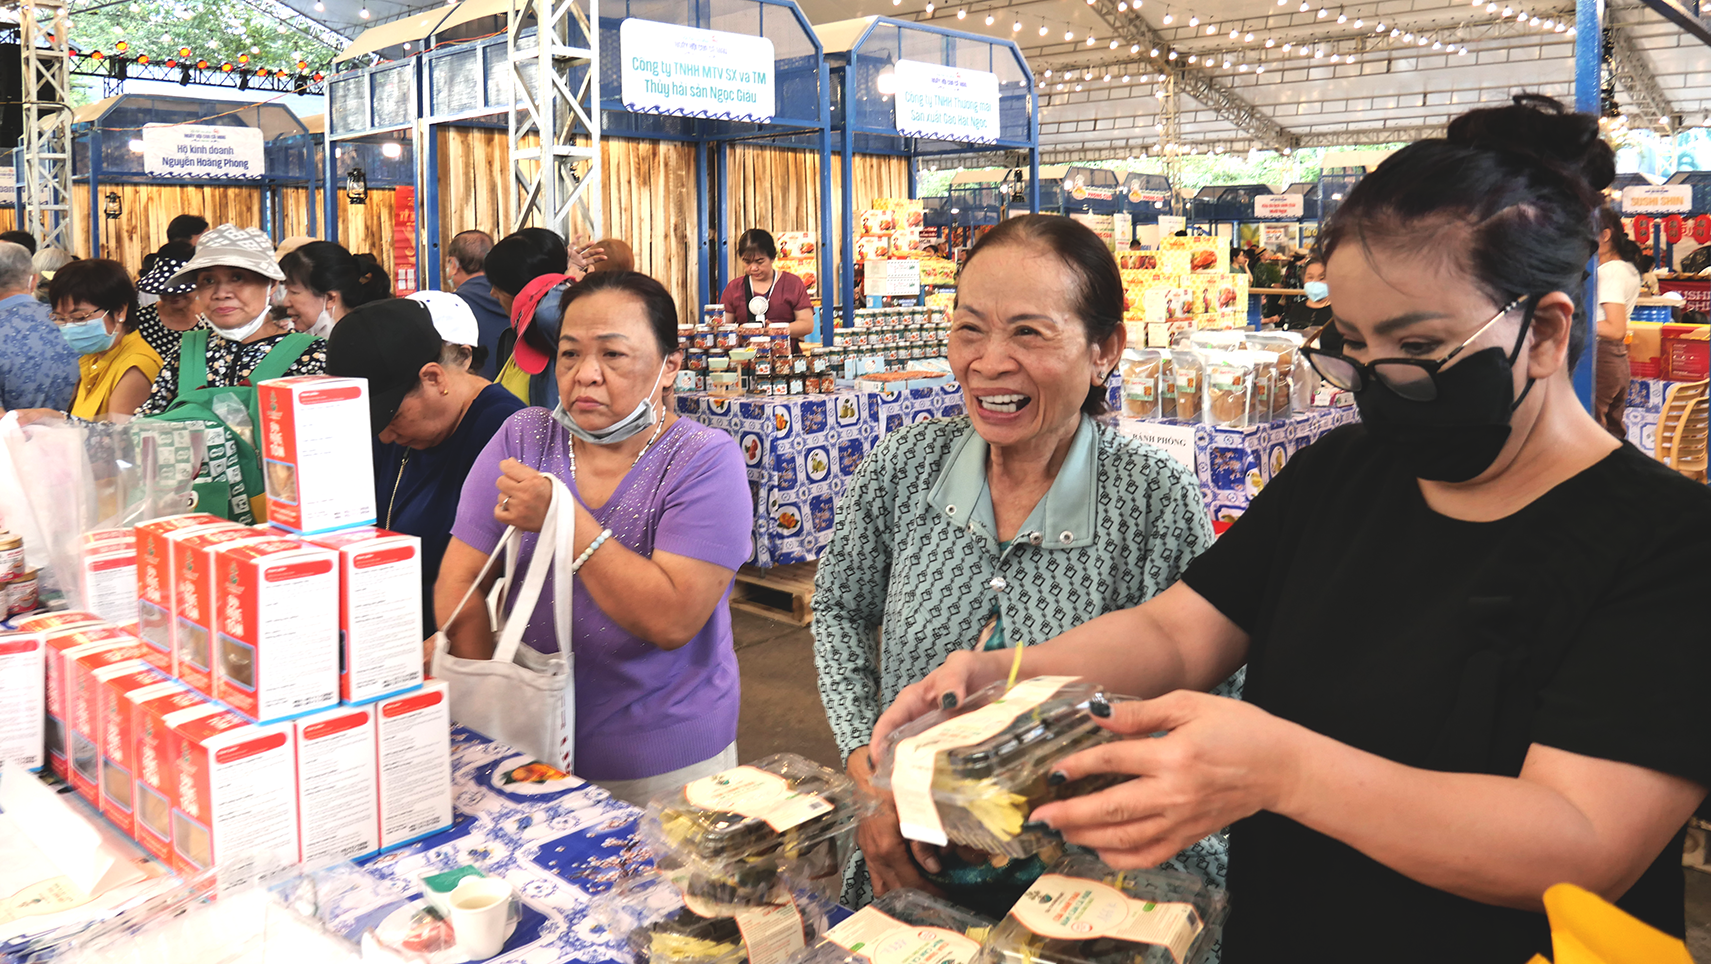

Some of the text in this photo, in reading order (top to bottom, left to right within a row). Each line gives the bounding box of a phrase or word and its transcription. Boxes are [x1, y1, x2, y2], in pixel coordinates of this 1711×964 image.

[632, 56, 658, 76] Công
[661, 61, 671, 77] ty
[674, 62, 700, 77] TNHH
[702, 65, 723, 80] MTV
[726, 68, 737, 81] SX
[752, 71, 766, 84] TM
[645, 78, 669, 98] Thủy
[672, 81, 687, 96] hải
[690, 83, 707, 98] sản
[710, 86, 734, 103] Ngọc
[934, 95, 952, 108] TNHH
[177, 144, 234, 155] Hộ kinh doanh
[162, 156, 249, 170] Nguyễn Hoàng Phong
[1631, 196, 1684, 206] SUSHI SHIN
